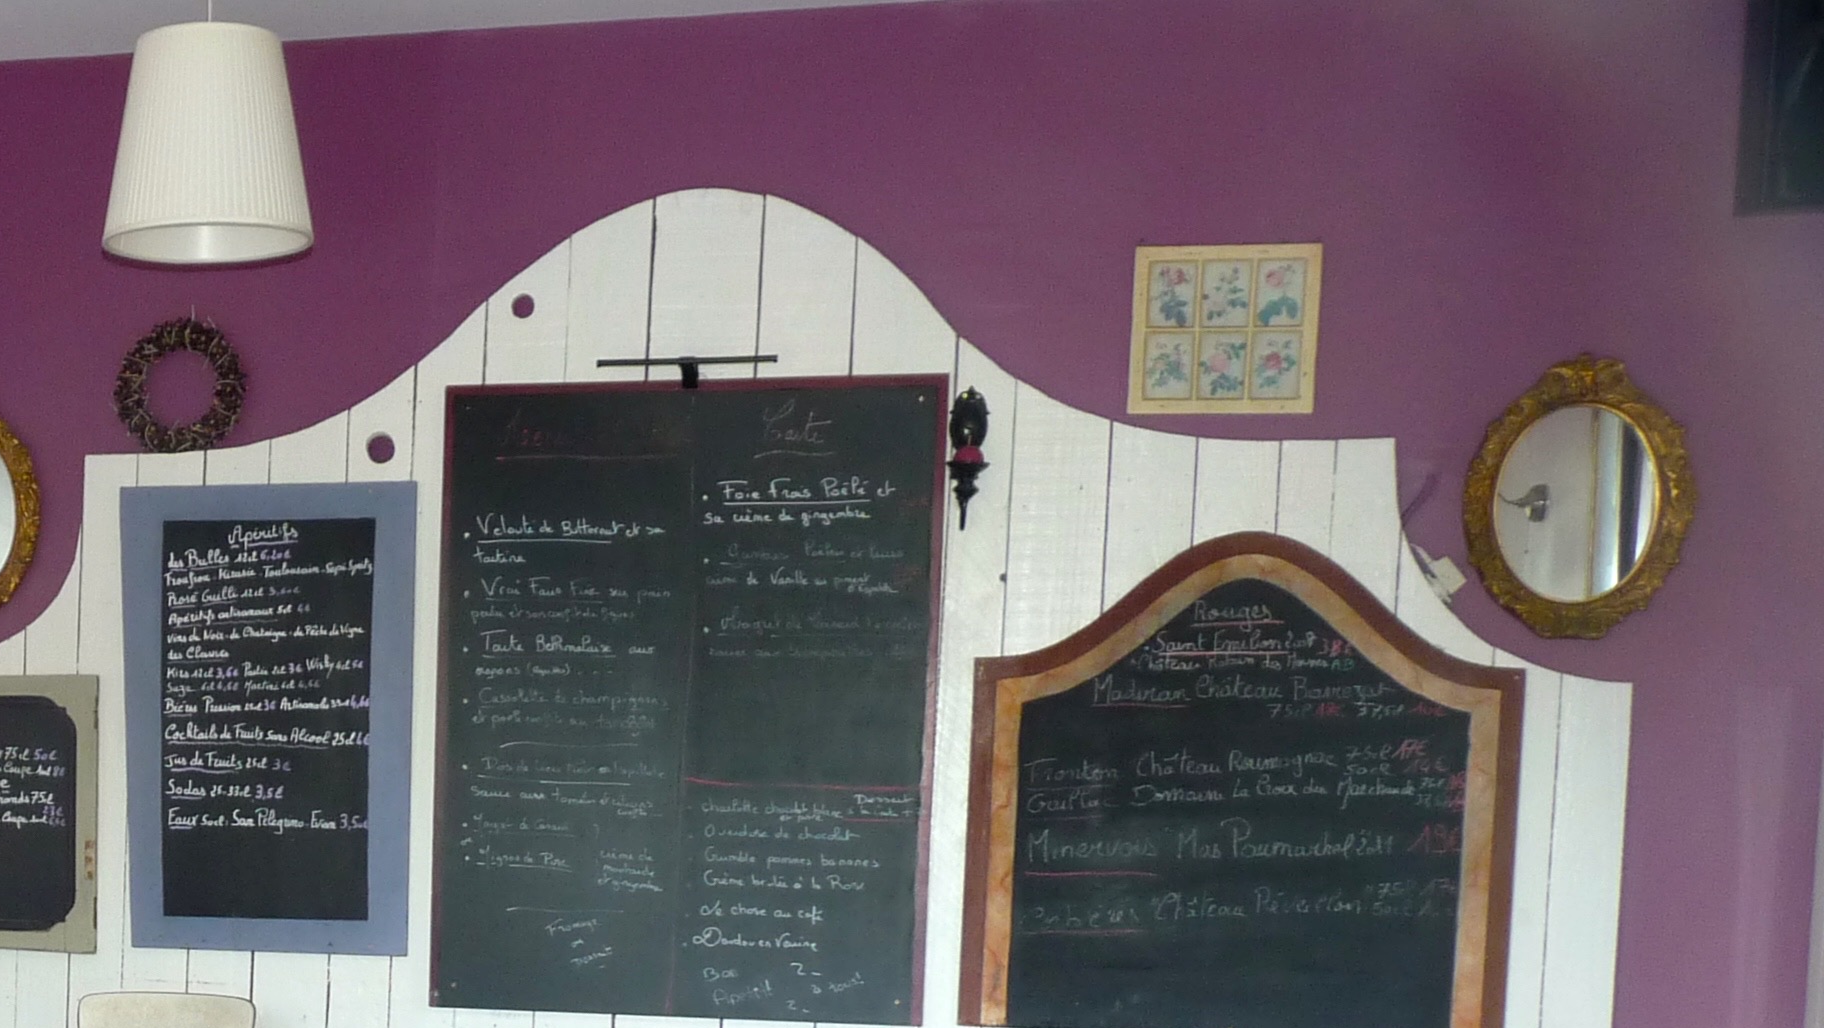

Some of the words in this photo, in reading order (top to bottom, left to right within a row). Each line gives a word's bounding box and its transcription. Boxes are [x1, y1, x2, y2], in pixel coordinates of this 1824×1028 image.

[717, 480, 761, 499] Foie
[876, 481, 896, 498] et
[778, 509, 796, 522] de
[801, 506, 872, 526] gingembre
[539, 519, 555, 534] de
[228, 523, 298, 551] Apéritifs
[185, 549, 229, 567] Bulles
[165, 721, 218, 740] Cocktails
[219, 724, 232, 739] de
[233, 722, 264, 740] Fruits
[290, 727, 331, 744] Alcool
[164, 754, 187, 768] Jus
[189, 751, 204, 766] de
[205, 751, 243, 770] Fruits
[165, 778, 207, 797] Sodas
[168, 807, 199, 827] Eaux
[231, 809, 256, 827] San
